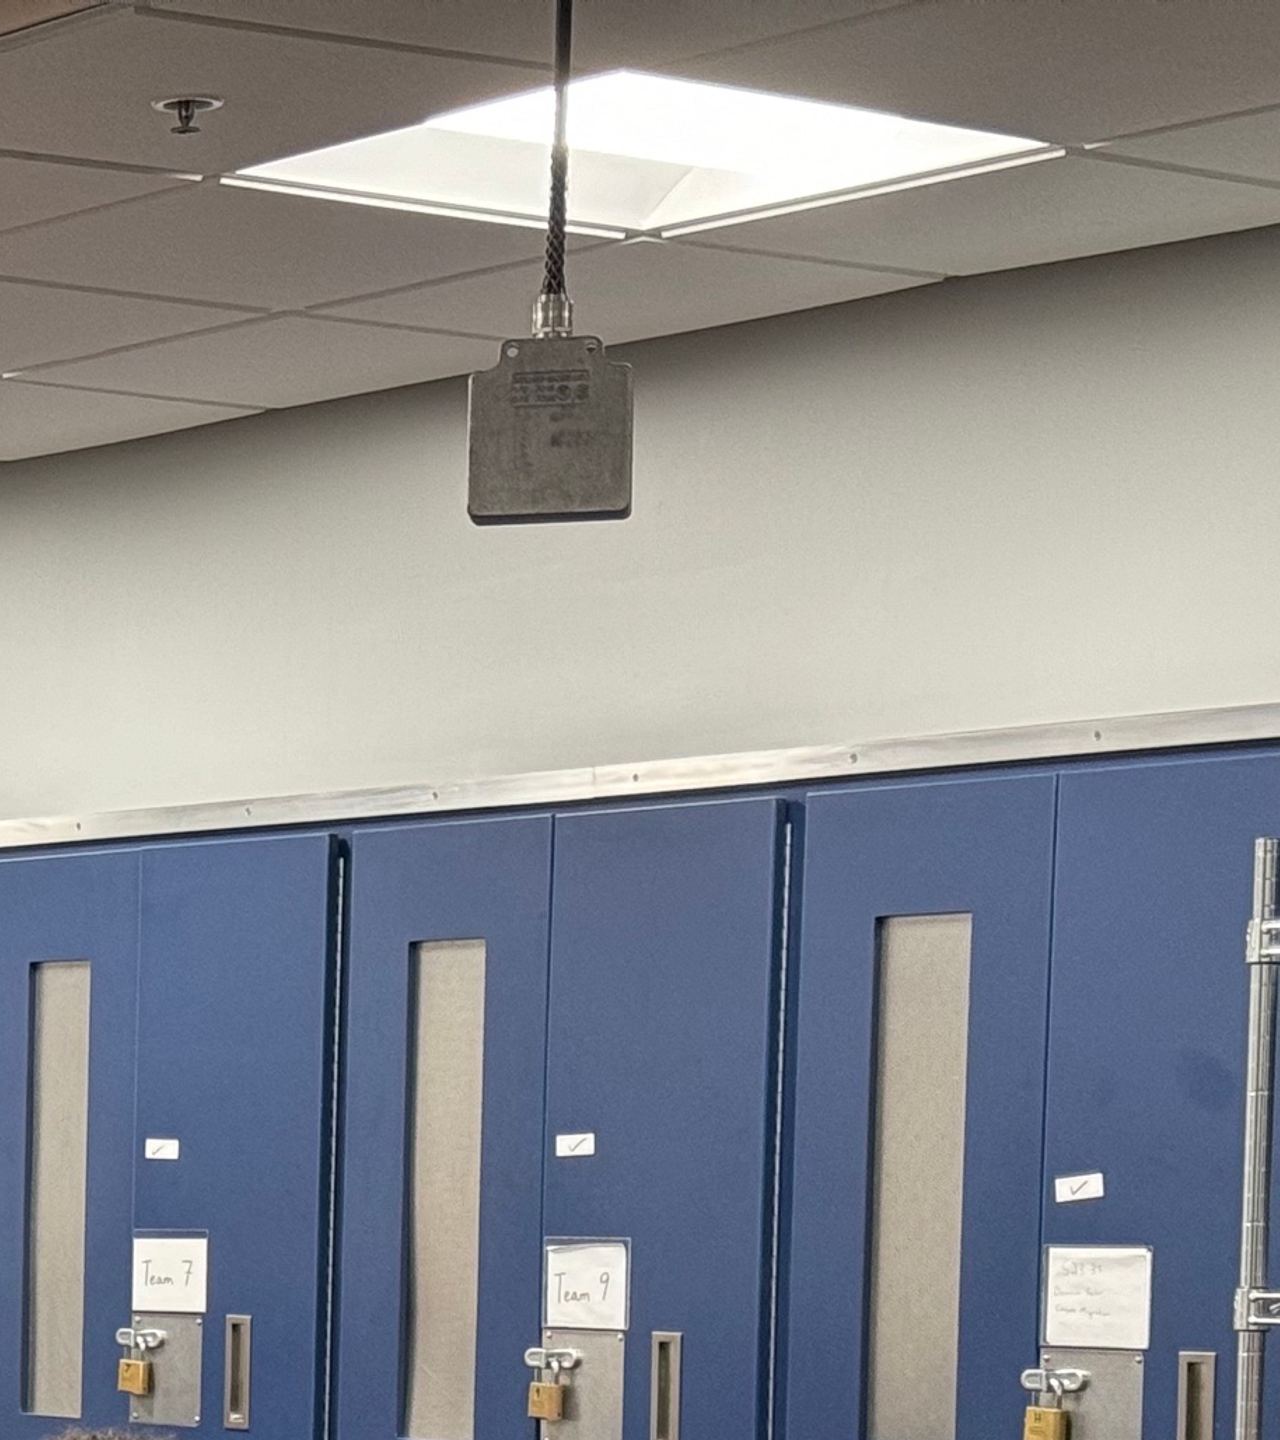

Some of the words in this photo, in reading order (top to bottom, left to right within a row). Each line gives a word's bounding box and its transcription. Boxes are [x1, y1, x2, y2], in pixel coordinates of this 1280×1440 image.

[141, 1259, 174, 1287] Team
[181, 1260, 193, 1287] 7
[554, 1272, 591, 1304] Team
[599, 1271, 610, 1301] 9
